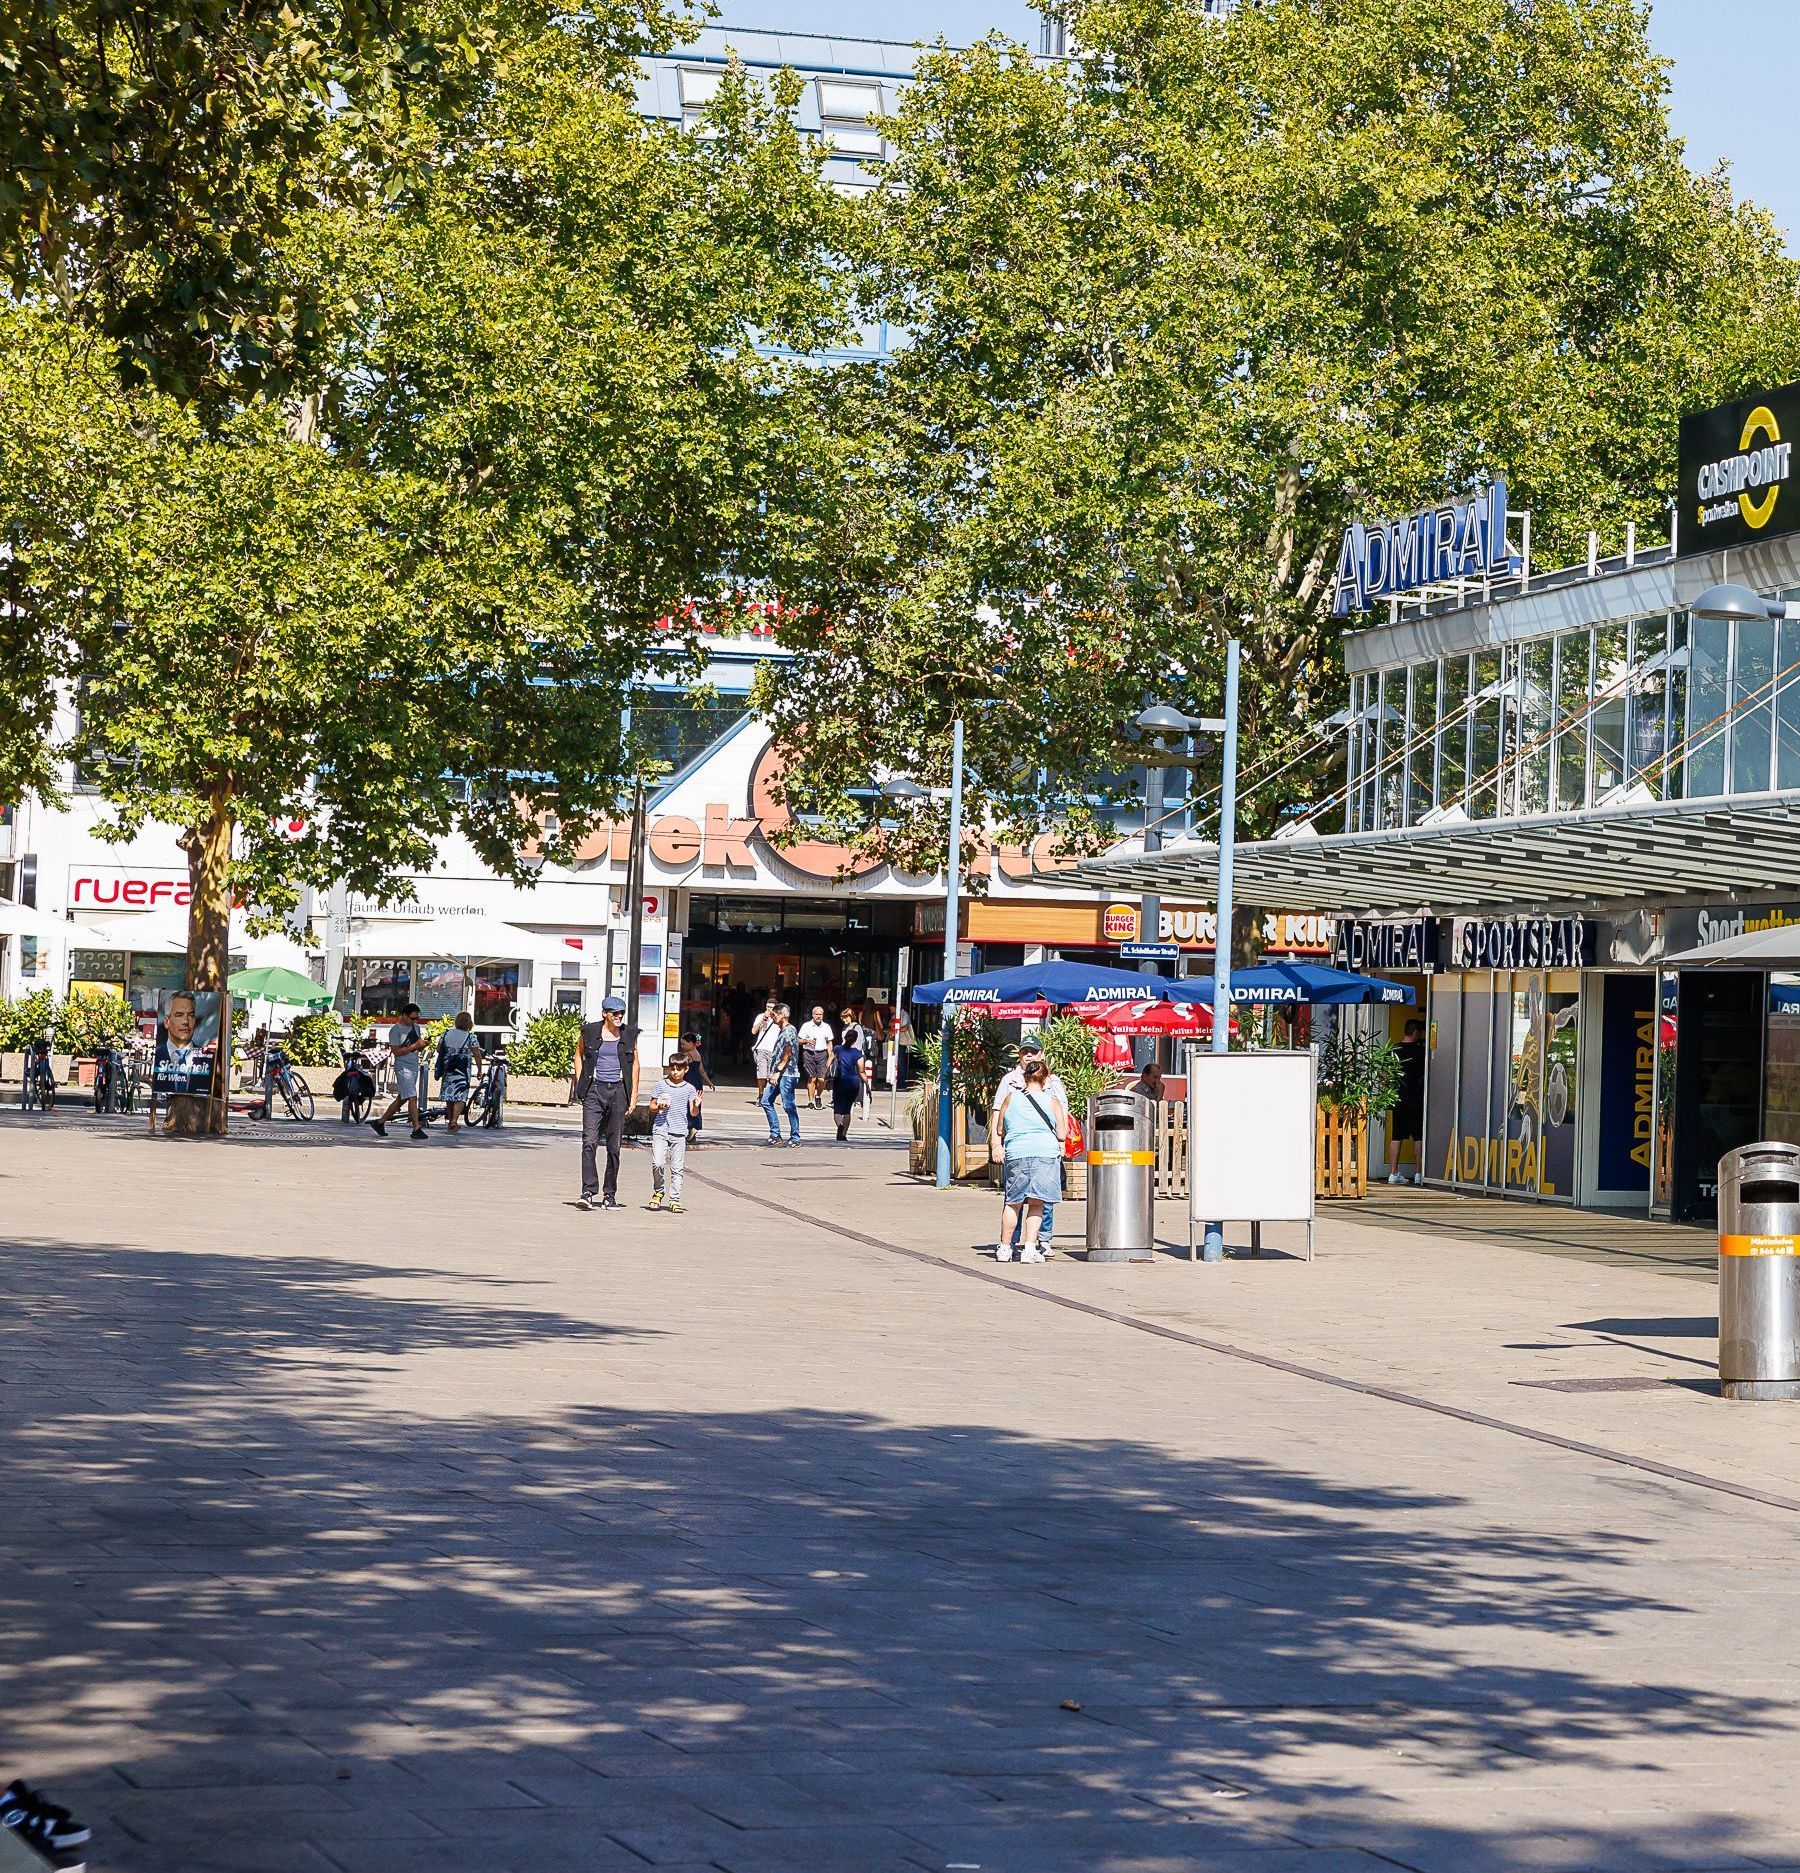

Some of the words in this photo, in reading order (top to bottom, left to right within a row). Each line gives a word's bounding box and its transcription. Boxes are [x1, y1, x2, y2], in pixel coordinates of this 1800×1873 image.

[1697, 443, 1791, 500] CASHPOINT
[1331, 482, 1516, 617] ADMIRAL
[393, 902, 434, 915] Urlaub
[1105, 914, 1135, 923] BURGER
[1105, 922, 1135, 932] KING
[1159, 910, 1278, 942] BURR
[1285, 914, 1337, 944] KIN
[1333, 917, 1434, 974] ADMIRAL
[1464, 920, 1584, 968] SPORTSBAR
[943, 988, 1001, 1002] ADMIRAL
[1085, 985, 1157, 1001] ADMIRAL
[1381, 987, 1404, 1002] ADMIRAL
[1140, 1026, 1163, 1034] Meinl
[1170, 1027, 1194, 1035] Julius
[1195, 1027, 1214, 1035] Mein
[159, 1060, 209, 1073] Sicherheit
[157, 1073, 167, 1081] für
[1443, 1128, 1555, 1195] ADMIRAL
